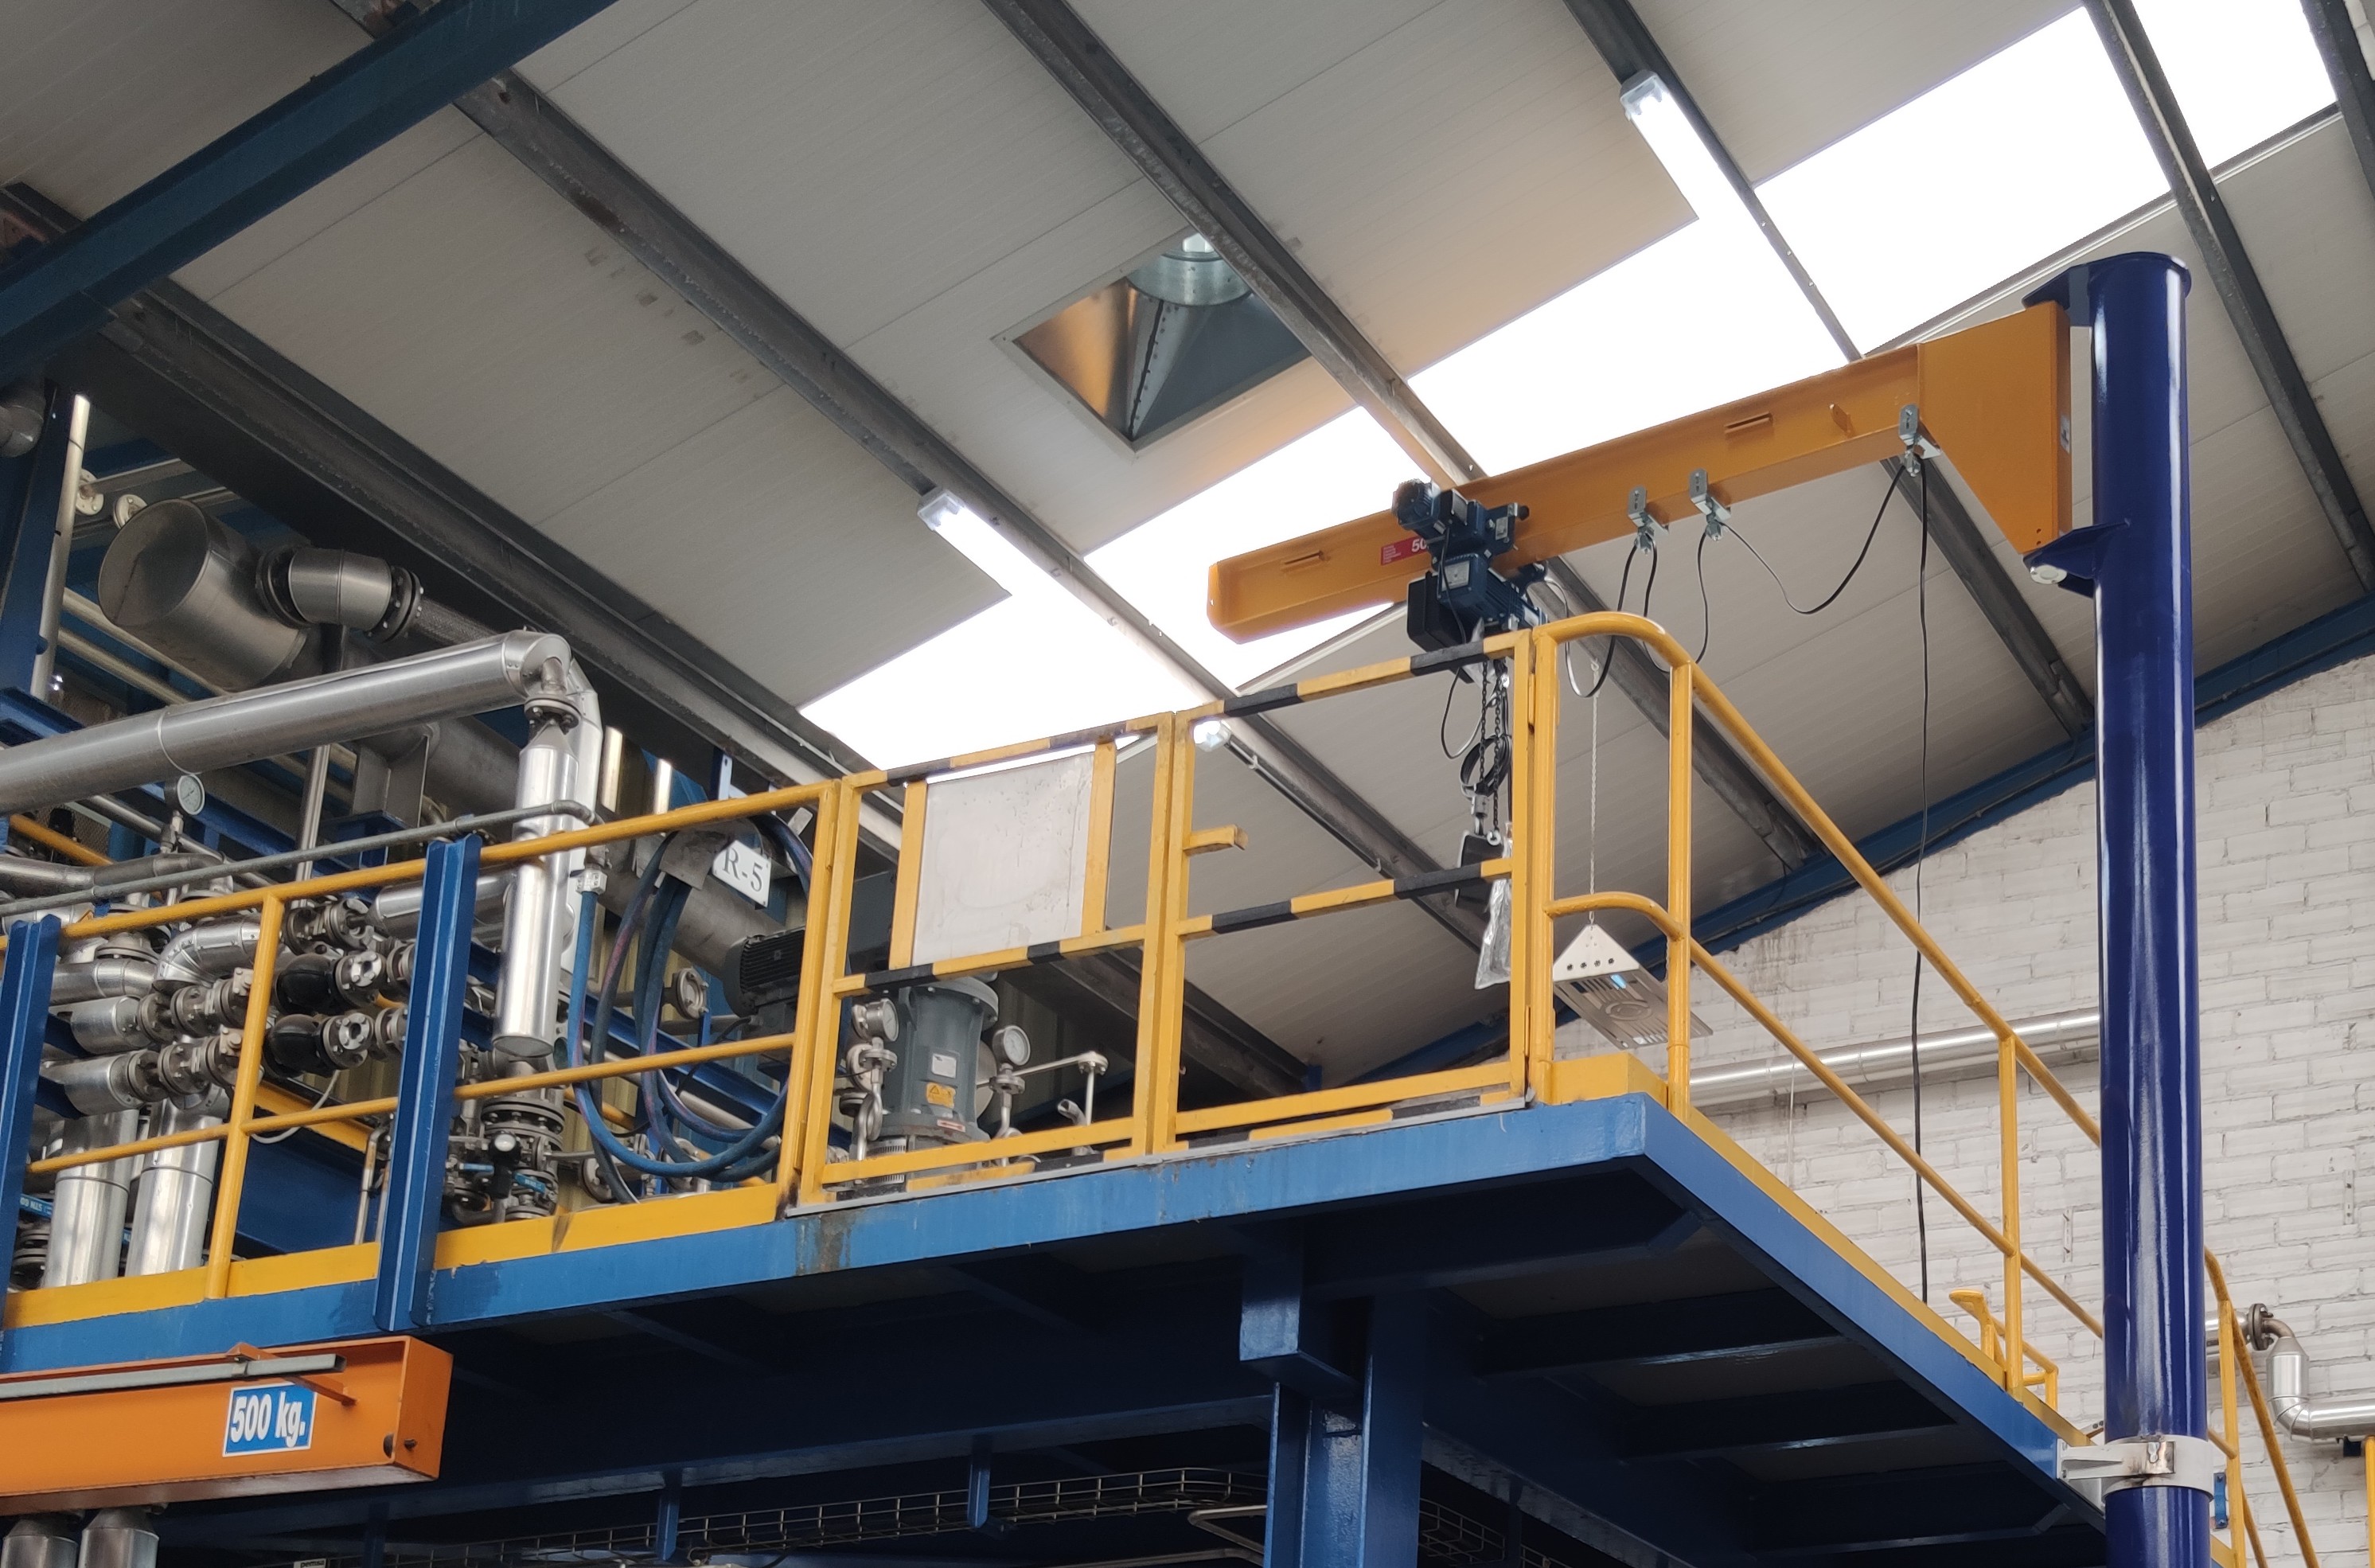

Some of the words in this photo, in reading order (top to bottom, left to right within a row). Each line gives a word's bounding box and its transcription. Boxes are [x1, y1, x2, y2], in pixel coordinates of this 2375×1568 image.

[723, 848, 762, 892] R-5
[230, 1394, 272, 1442] 500
[275, 1391, 306, 1448] kg.
